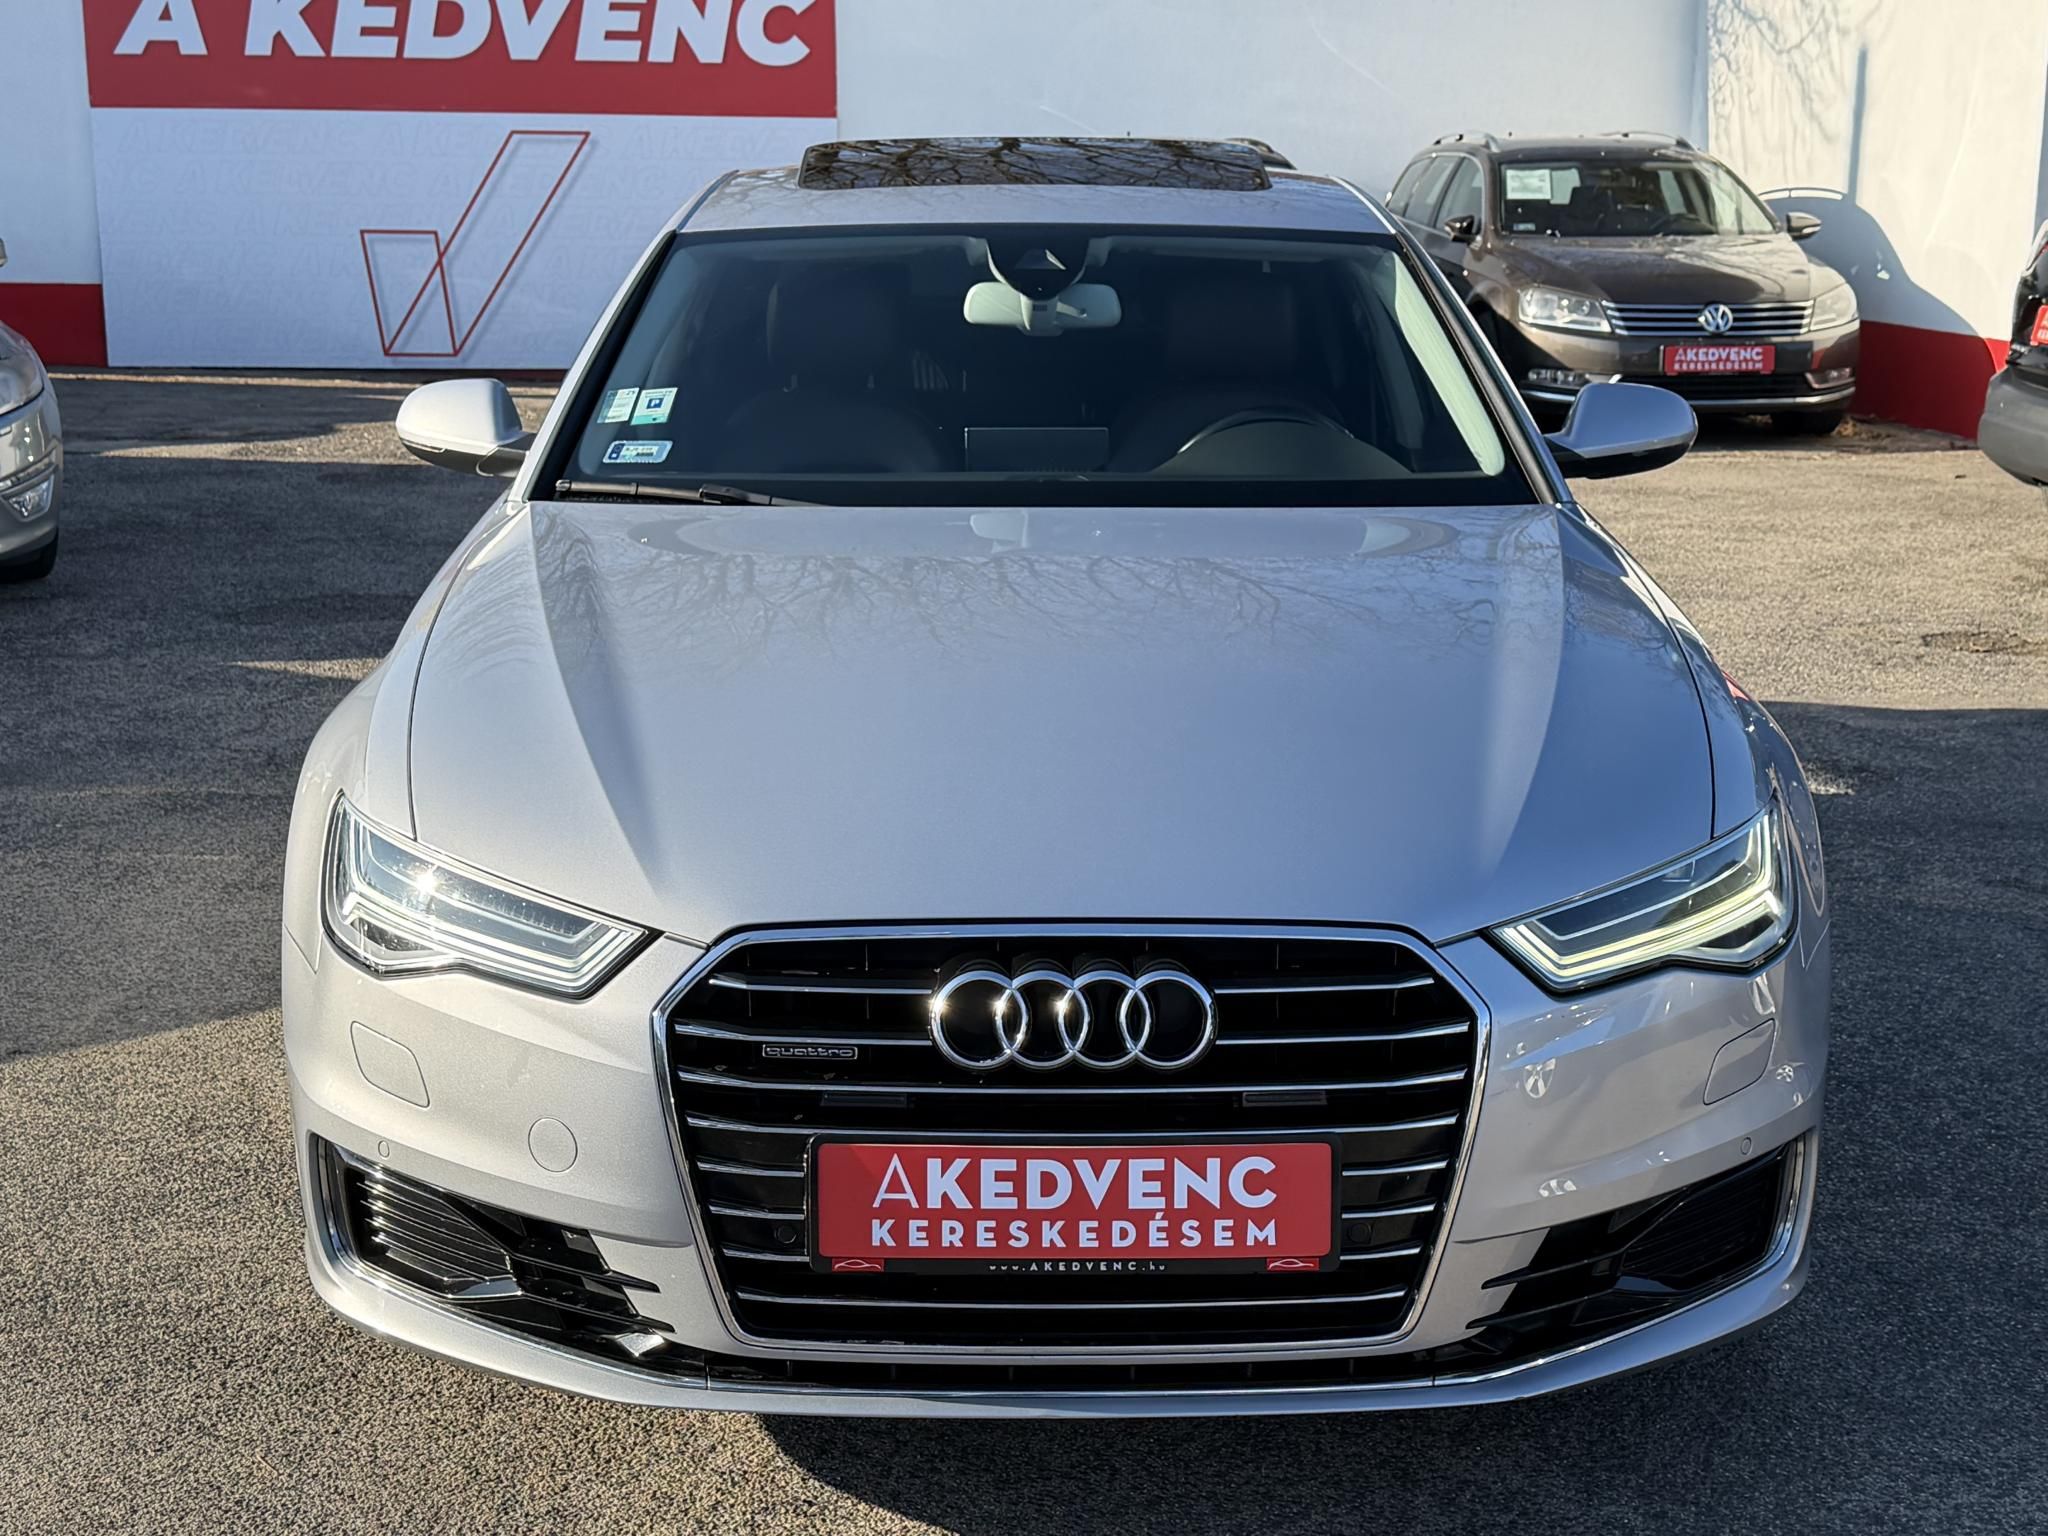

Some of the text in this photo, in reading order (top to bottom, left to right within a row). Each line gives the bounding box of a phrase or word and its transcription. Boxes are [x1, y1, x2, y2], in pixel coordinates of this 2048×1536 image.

[114, 0, 816, 67] A KEDVENC
[766, 1047, 854, 1057] quattro
[872, 1152, 1277, 1210] AKEDVENC
[871, 1212, 1277, 1248] KERESKEDÉSEM
[989, 1261, 1166, 1272] www.AKEDVENC.hu
